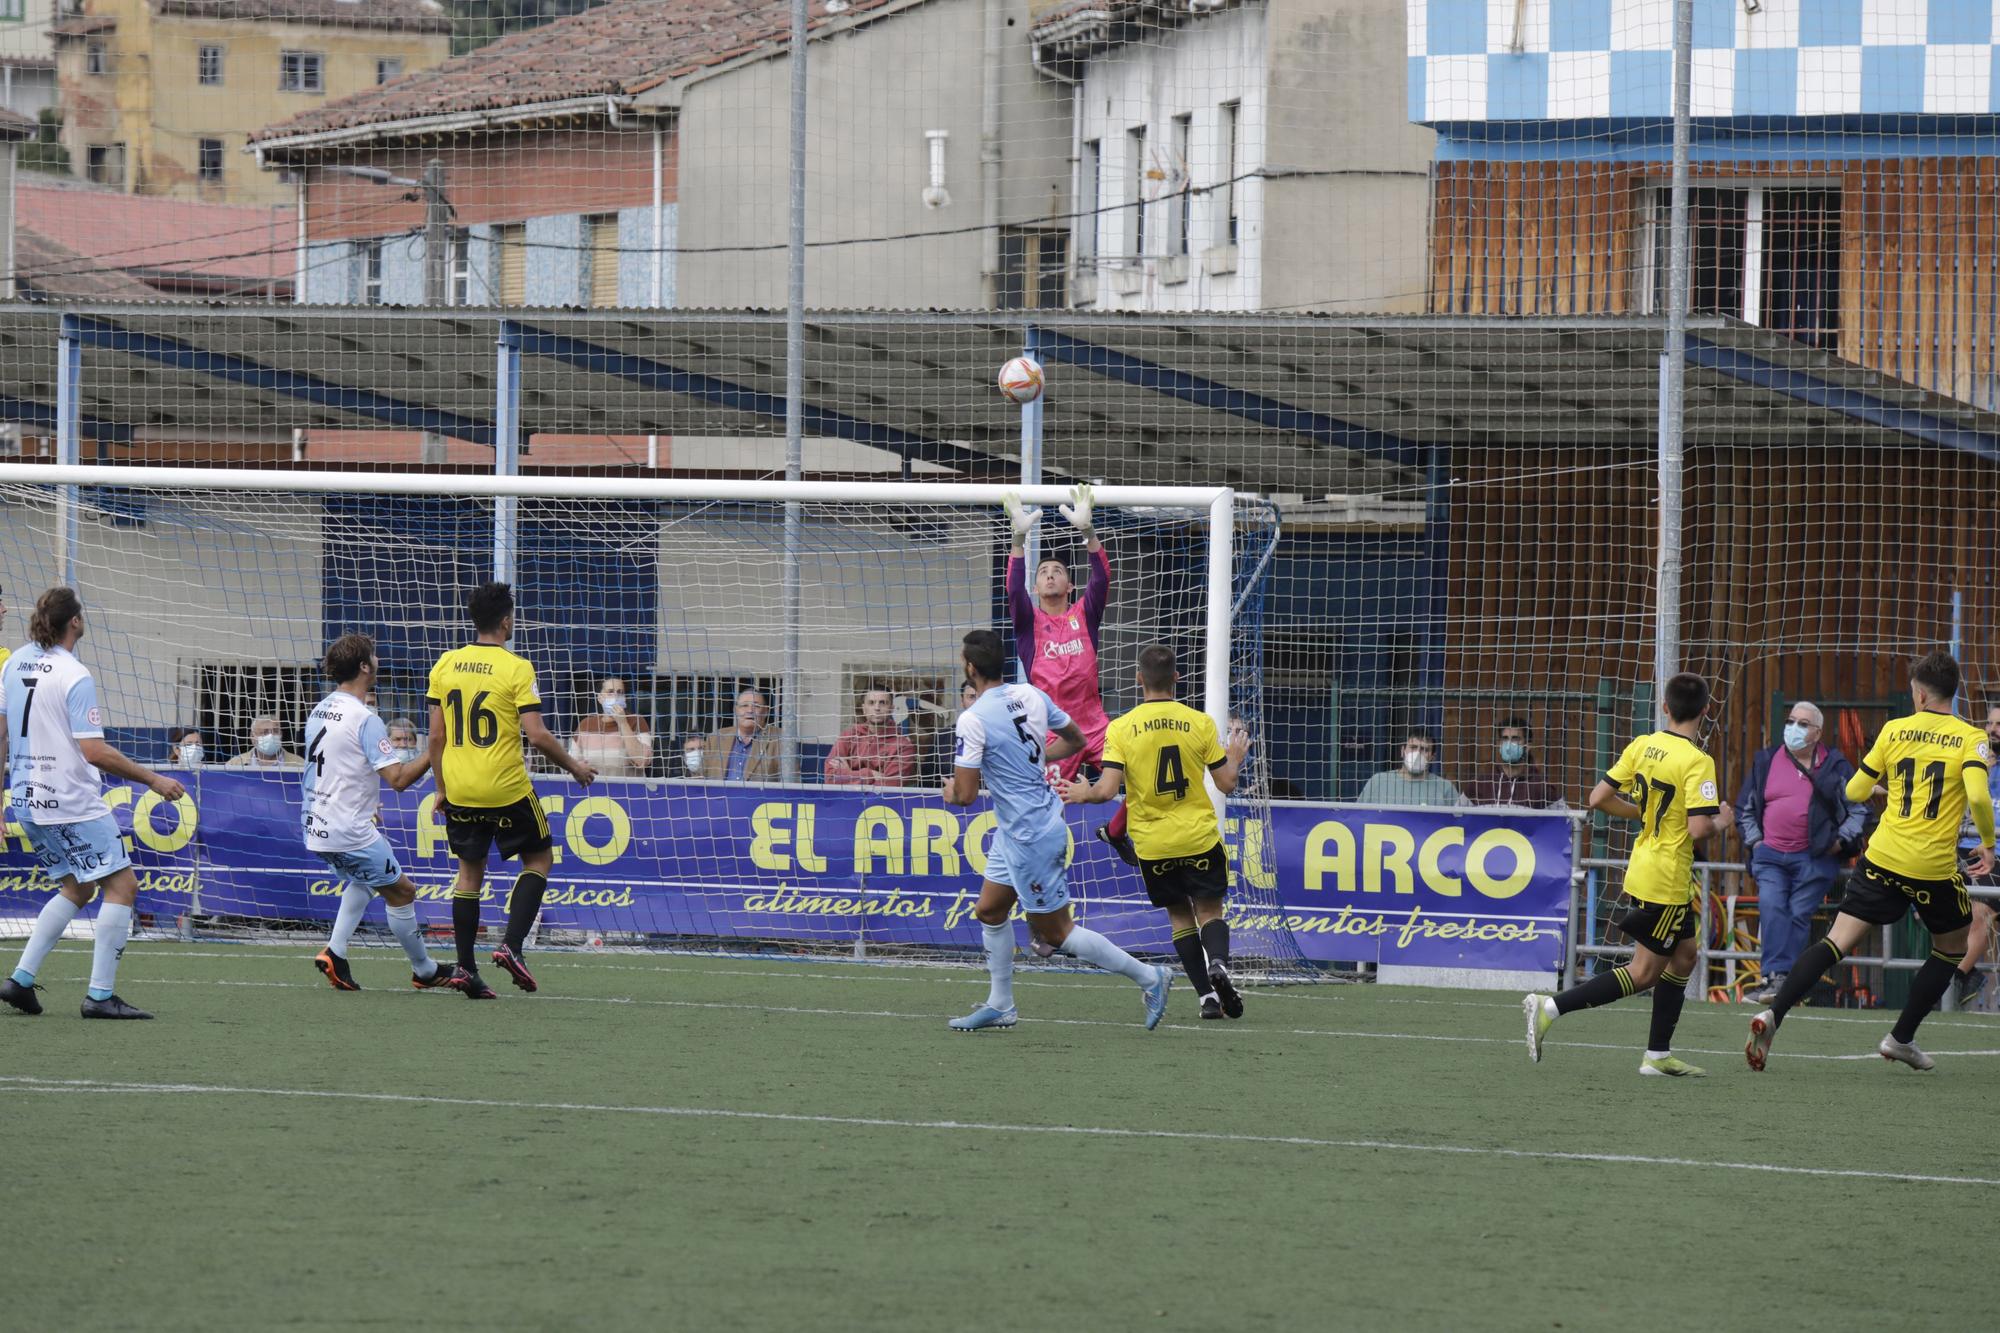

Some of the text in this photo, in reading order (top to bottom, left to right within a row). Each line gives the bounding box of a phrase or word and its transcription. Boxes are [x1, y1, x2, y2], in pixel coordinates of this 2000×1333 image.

[17, 661, 53, 673] JANDRO
[453, 662, 493, 676] MANGEL
[21, 678, 39, 738] 7
[446, 689, 498, 749] 16
[1006, 701, 1025, 713] BENI
[1143, 717, 1190, 733] MORENO
[308, 725, 326, 777] 4
[1012, 714, 1041, 764] 5
[1154, 744, 1190, 801] 4
[1894, 757, 1946, 820] 11
[750, 802, 827, 873] EL
[1304, 820, 1536, 899] ARCO
[744, 881, 935, 918] alimentos
[1397, 905, 1539, 949] frescos
